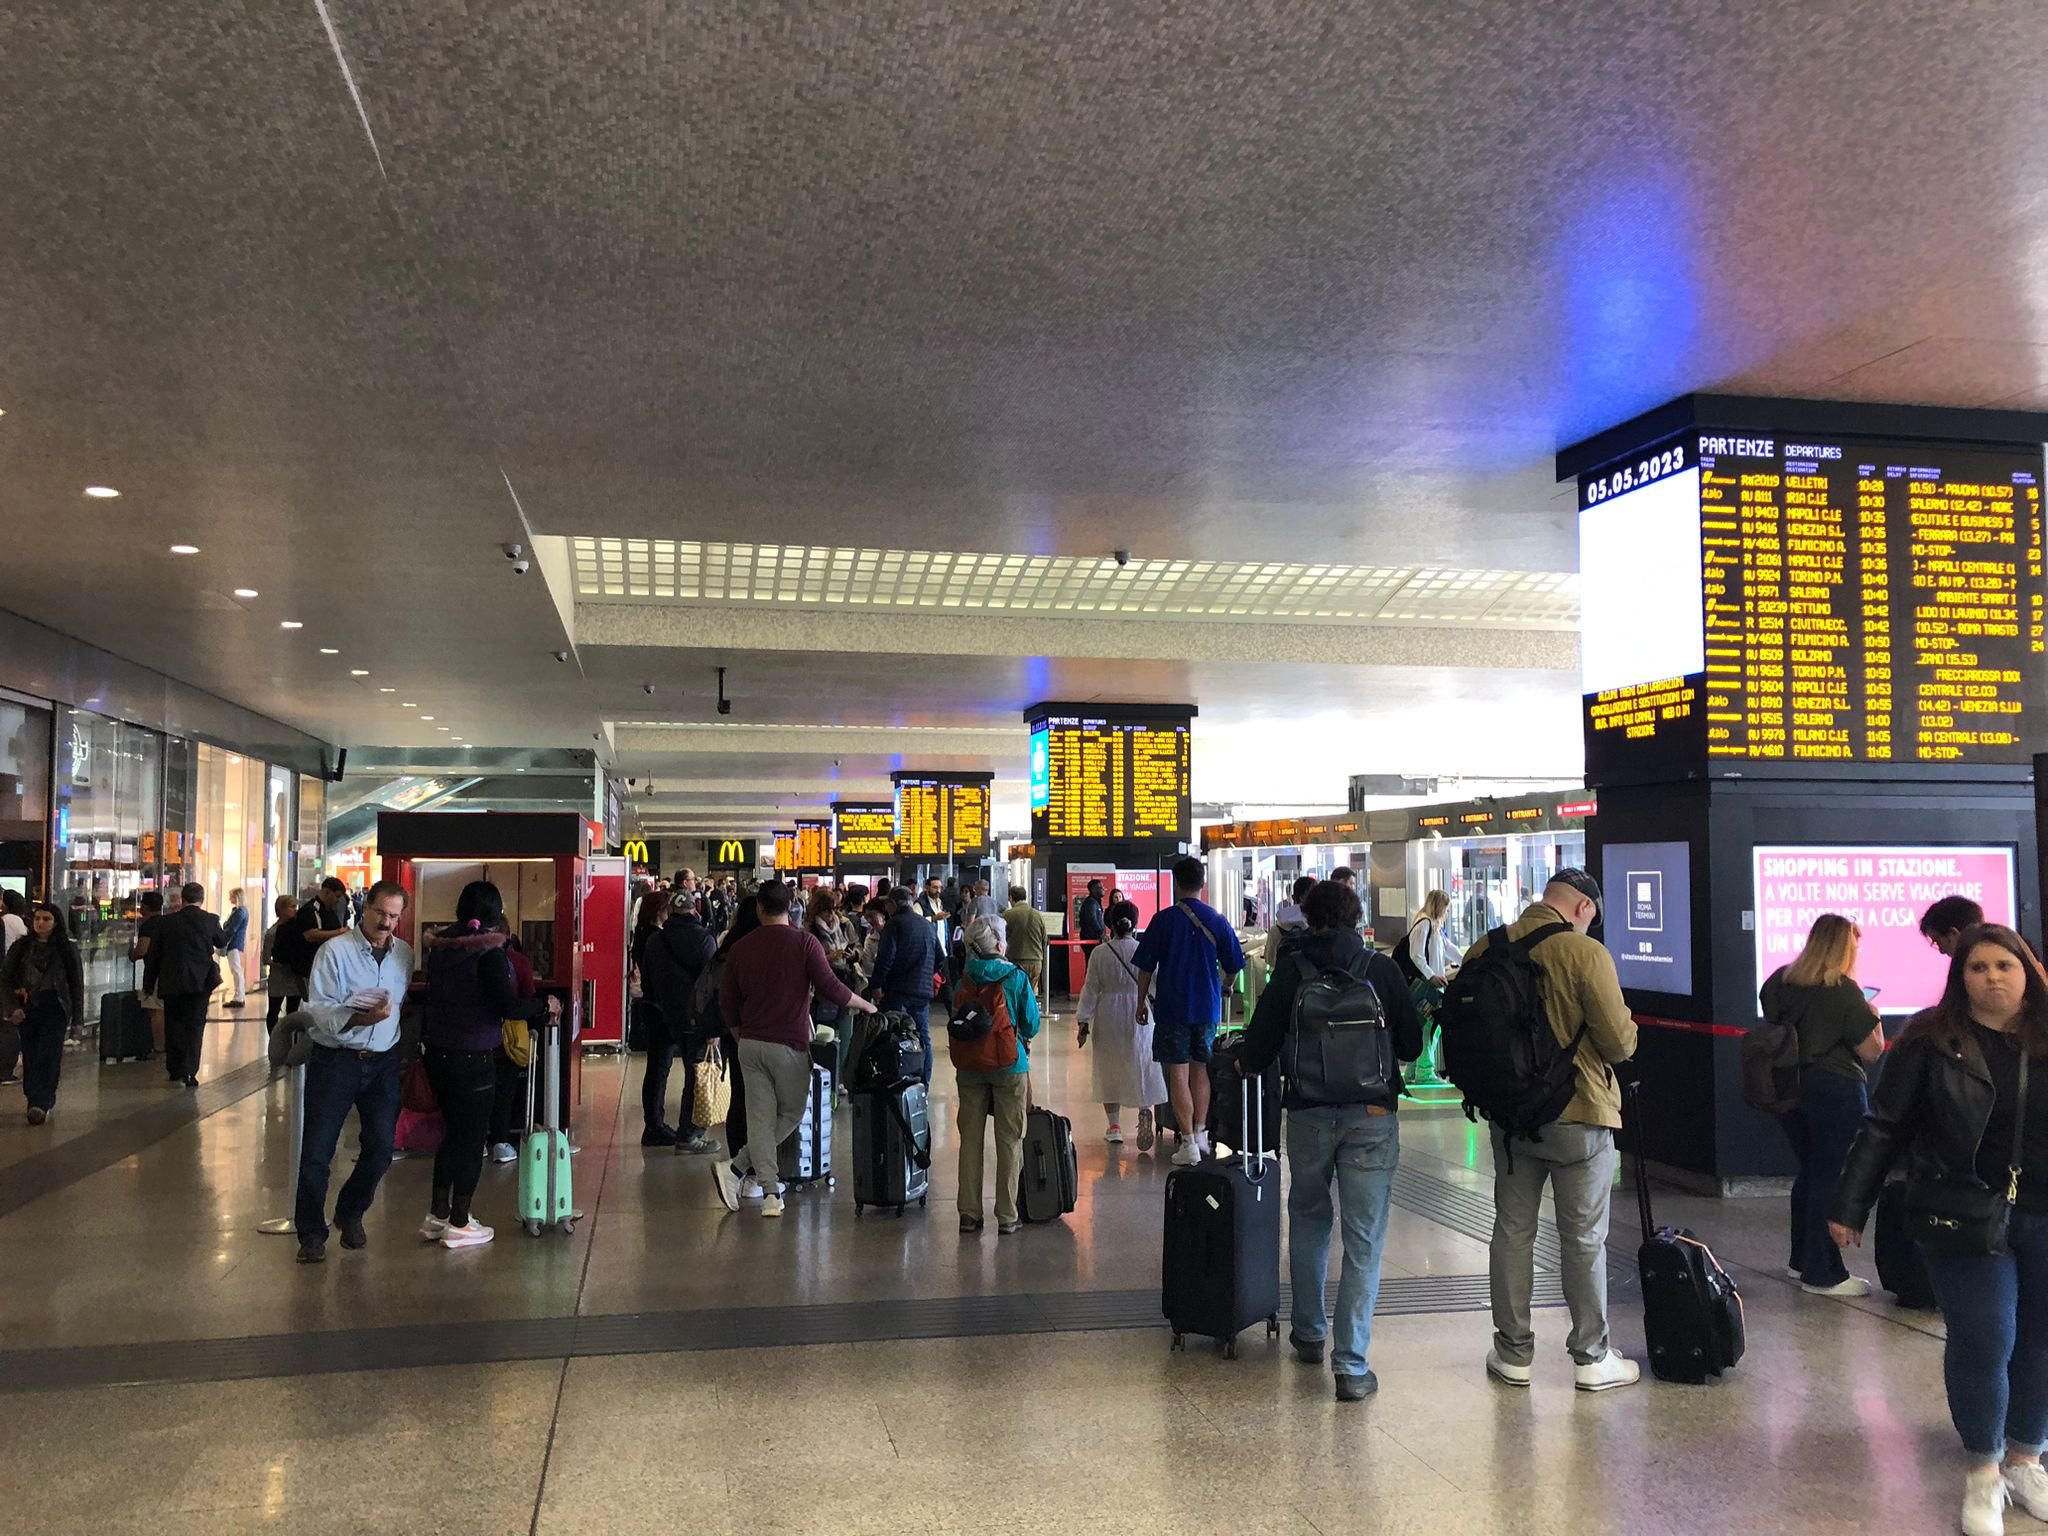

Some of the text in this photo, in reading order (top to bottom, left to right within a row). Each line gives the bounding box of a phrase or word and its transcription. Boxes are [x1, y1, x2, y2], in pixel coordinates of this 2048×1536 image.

[1699, 437, 1842, 459] PARTENZE DEPARTURES
[1588, 446, 1684, 504] 05.05.2023
[1786, 476, 1828, 489] VELLETRI
[1858, 480, 1884, 492] 10:28
[1754, 490, 1772, 502] 8111
[1808, 493, 1828, 505] C.LE
[1858, 496, 1885, 508] 10:30
[1911, 498, 1948, 510] SALERNO
[1950, 499, 1982, 512] (12.42)
[2031, 504, 2039, 514] 7
[1756, 506, 1779, 519] 9403
[1787, 508, 1819, 520] NAPOLI
[1822, 509, 1842, 522] C.LE
[1859, 511, 1886, 523] 10:35
[1952, 515, 1959, 526] E
[1961, 516, 2004, 528] BUSINESS
[2032, 519, 2040, 530] 5
[1756, 522, 2041, 545] 9416 VENEZIA S.L. 10:35 FERRARA (13.27) 3
[1788, 539, 1835, 552] FIUMICINO
[1859, 543, 1887, 554] 10:35
[2027, 549, 2041, 560] 23
[1756, 554, 1782, 566] 21061
[1788, 555, 1820, 568] NAPOLI
[1823, 556, 1844, 569] C.LE
[1861, 558, 1887, 570] 10:36
[1928, 561, 1960, 573] NAPOLI
[1961, 561, 2005, 574] CENTRALE
[1757, 570, 1781, 581] 9924
[1789, 571, 1822, 583] TORINO
[1824, 572, 1843, 584] P.N.
[1862, 574, 1888, 586] 10:40
[1757, 586, 1779, 597] 9971
[1789, 587, 1830, 599] SALERNO
[1862, 590, 1888, 601] 10:40
[1937, 592, 1979, 604] AMBIENTE
[1981, 593, 2009, 605] SMART
[1757, 601, 1787, 613] 20239
[1790, 602, 1831, 614] NETTUNO
[1862, 605, 1889, 617] 10:42
[1916, 607, 1938, 618] LIDO
[1940, 607, 1950, 618] DI
[1952, 608, 1988, 620] LAVINIO
[1758, 617, 1784, 629] 12514
[1790, 618, 1848, 631] CIVITAVECC.
[1862, 621, 1889, 632] 10:42
[1916, 622, 1948, 634] (10.52)
[1958, 623, 1981, 635] ROMA
[2031, 625, 2044, 637] 27
[1791, 634, 1838, 646] FIUMICINO
[1864, 636, 1890, 648] 10:50
[1760, 649, 1978, 666] 8509 BOLZANO 10:50 (15.53)
[1760, 665, 2001, 681] 9626 TORINO P.N. 10:50 FRECCIAROSSA
[1760, 681, 1997, 697] 9604 NAPOLI C.LE 10:53 CENTRALE (12.03)
[1761, 697, 1783, 709] 8910
[1792, 698, 1832, 709] VENEZIA
[1833, 698, 1851, 710] S.L.
[1866, 699, 1892, 711] 10:55
[1918, 700, 1951, 712] (14.42)
[1961, 701, 1998, 712] VENEZIA
[1048, 717, 1079, 725] PARTENZE
[1762, 713, 1953, 728] 9515 SALERNO 11:00 (13.02)
[1626, 724, 1656, 738] STAZIONE
[1762, 729, 1785, 740] 9978
[1794, 729, 1826, 741] MILANO
[1828, 730, 1849, 742] C.LE
[1866, 731, 1891, 742] 11:05
[1934, 732, 1978, 743] CENTRALE
[1762, 745, 1784, 757] 4610
[1794, 745, 1841, 757] FIUMICINO
[1867, 746, 1891, 758] 11:05
[1512, 809, 1537, 818] ENTRANCE
[1764, 858, 1962, 877] SHOPPING IN STAZIONE.
[1765, 882, 1983, 901] A VOLTE NON SERVE VIAGGIARE
[1635, 911, 1656, 920] TERMINI
[1766, 908, 1916, 927] PER A CASA
[1767, 933, 1789, 953] UN
